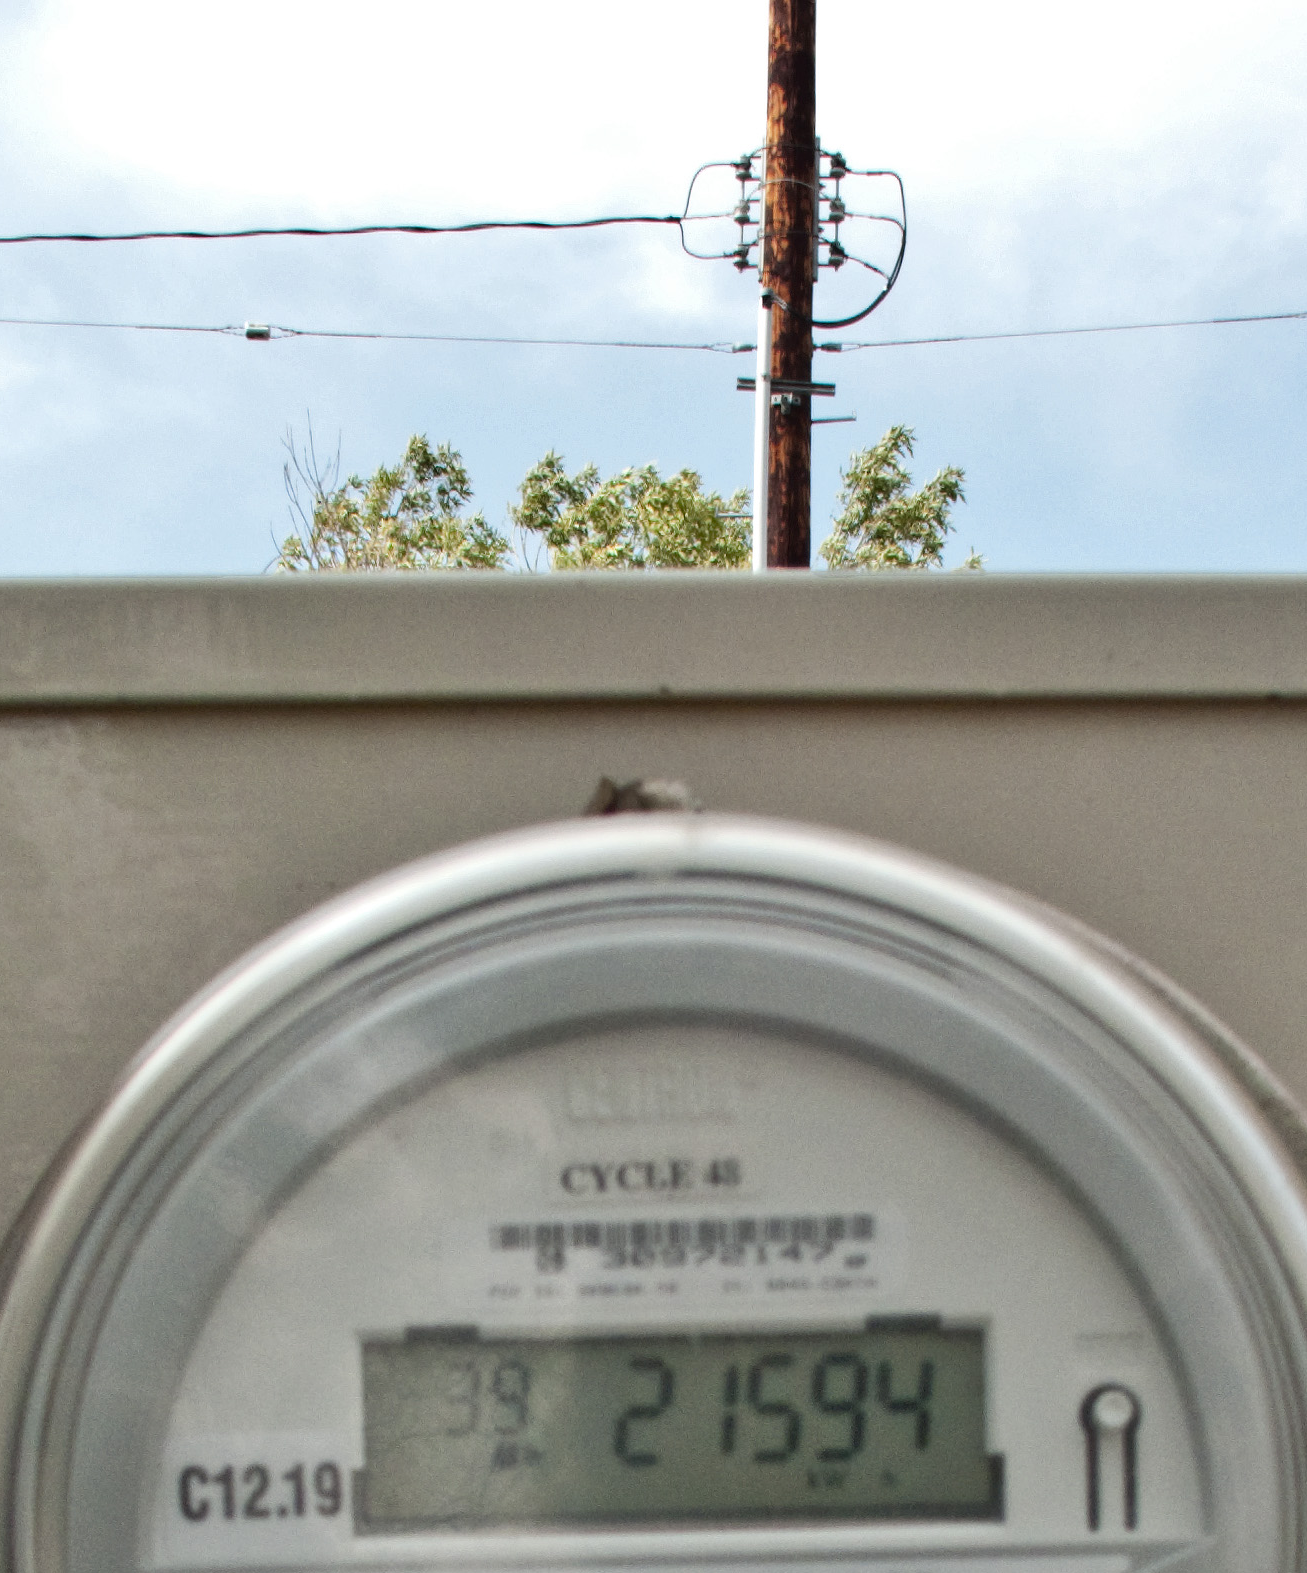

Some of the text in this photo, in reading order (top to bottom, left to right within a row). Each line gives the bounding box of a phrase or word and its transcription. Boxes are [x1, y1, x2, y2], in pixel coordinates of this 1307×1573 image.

[560, 1158, 692, 1194] CYCLE
[615, 1352, 934, 1468] 21594
[178, 1462, 342, 1522] C12.19
